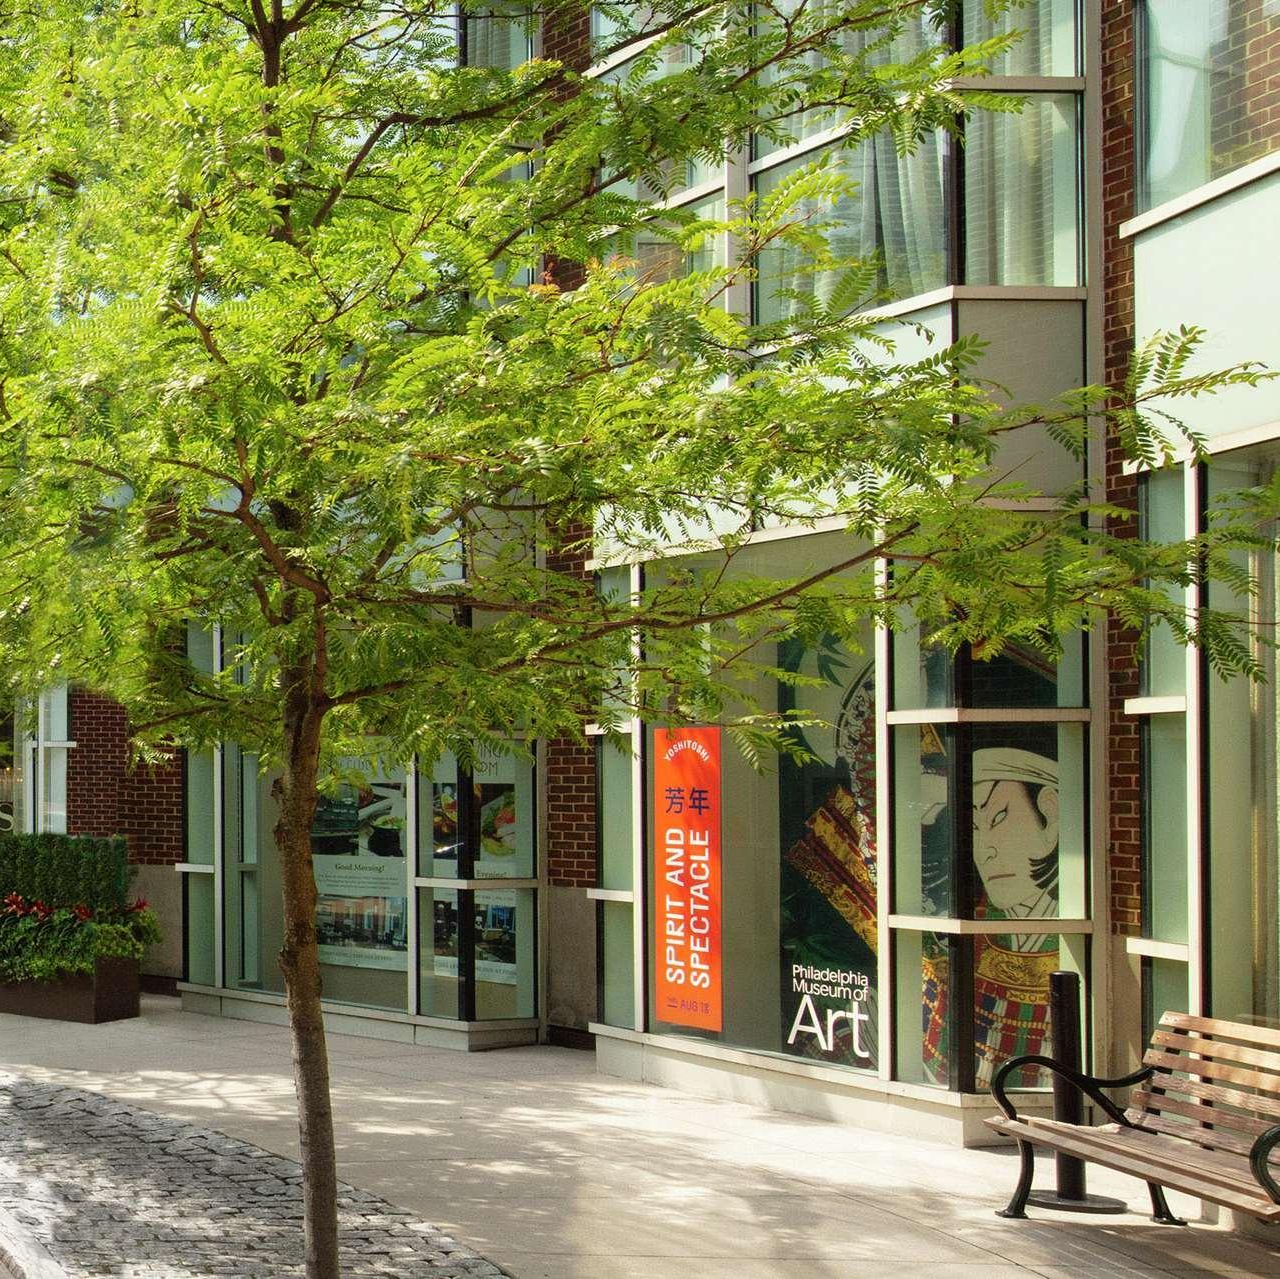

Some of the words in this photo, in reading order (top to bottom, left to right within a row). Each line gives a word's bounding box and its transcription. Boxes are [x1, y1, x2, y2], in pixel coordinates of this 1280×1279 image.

[664, 739, 710, 762] YOSHITOSHI
[665, 786, 710, 816] 芳年
[665, 827, 685, 887] AND
[690, 829, 711, 989] SPECTACLE
[665, 894, 685, 985] SPIRIT
[792, 964, 869, 986] Philadelphia
[792, 978, 852, 1000] Museum
[853, 986, 869, 1002] of
[787, 994, 870, 1058] Art
